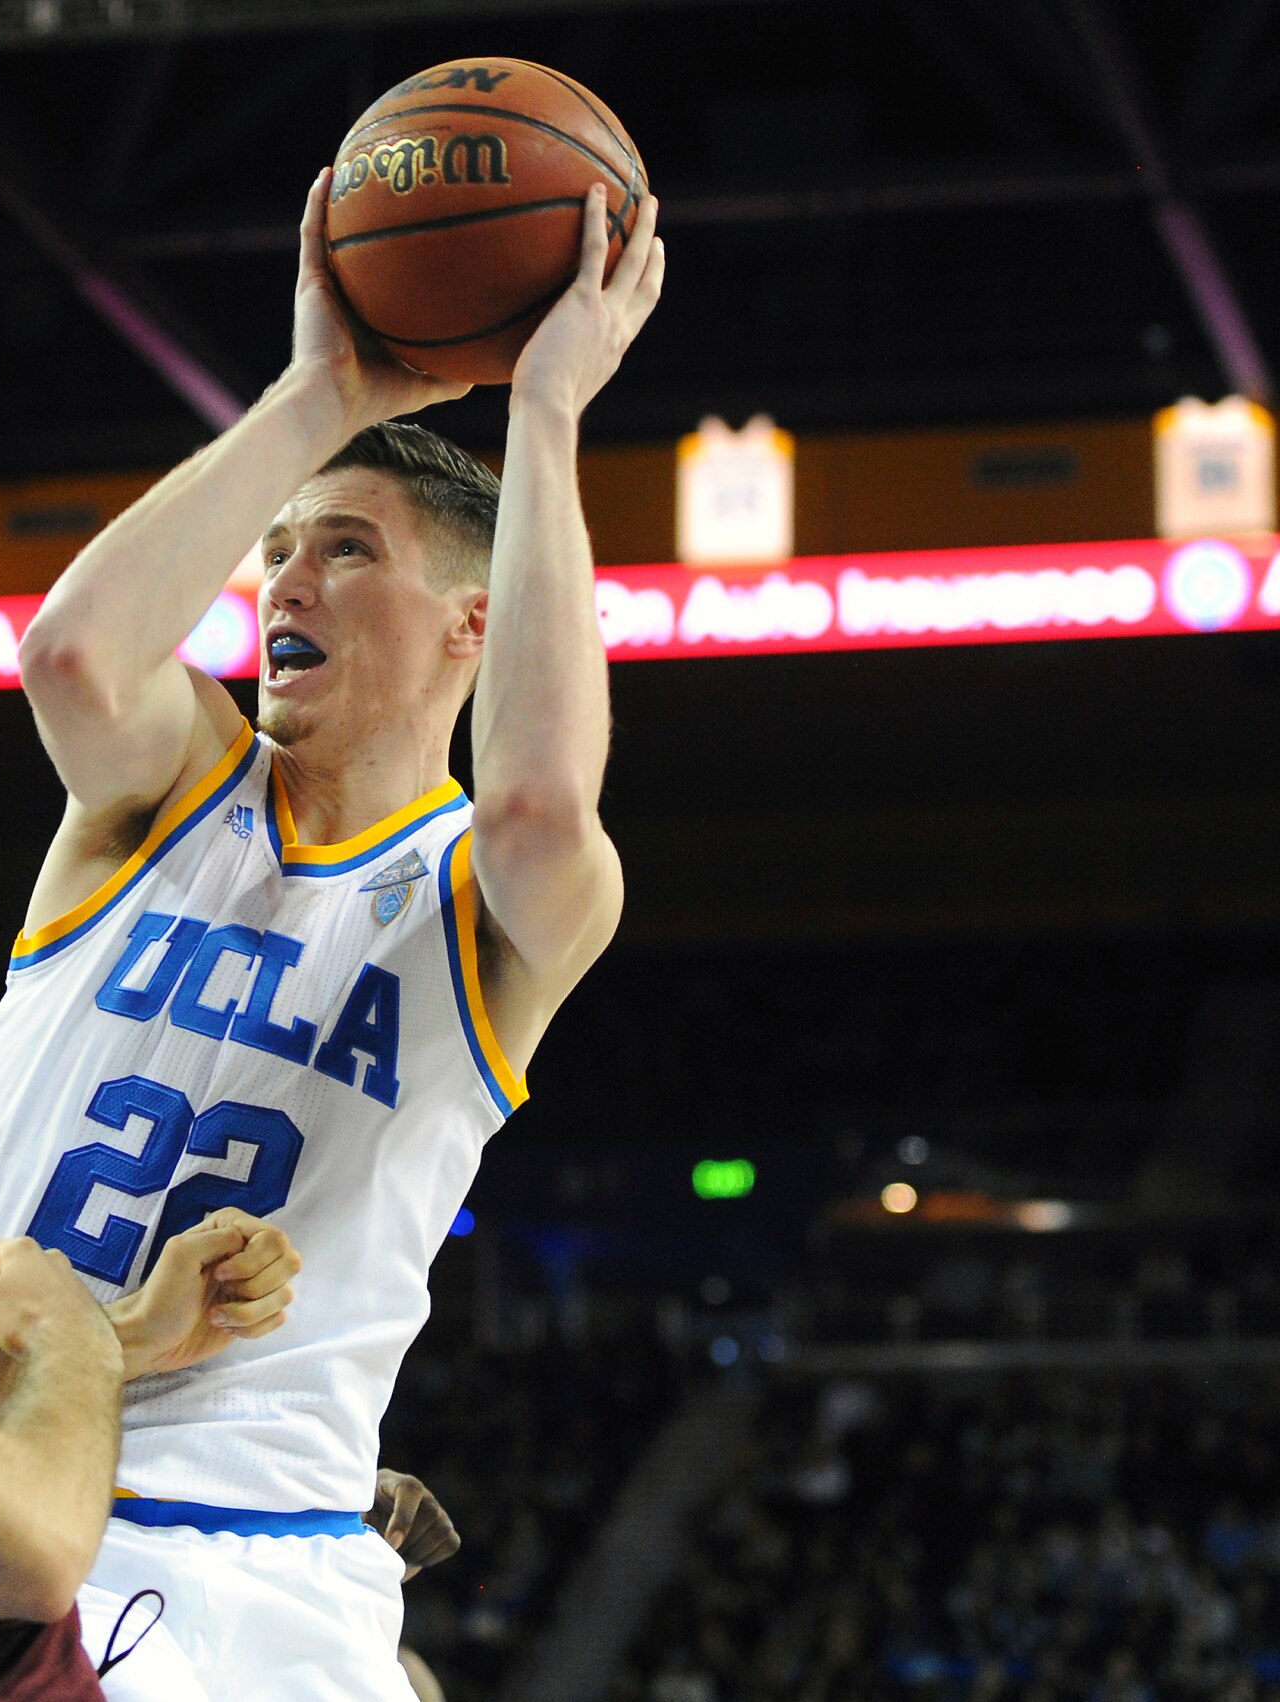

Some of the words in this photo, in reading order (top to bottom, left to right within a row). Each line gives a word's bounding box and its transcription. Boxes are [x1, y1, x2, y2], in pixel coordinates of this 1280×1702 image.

[678, 571, 834, 643] Auto
[837, 567, 1158, 637] Insurance
[95, 911, 401, 1110] UCLA
[26, 1074, 305, 1288] 22
